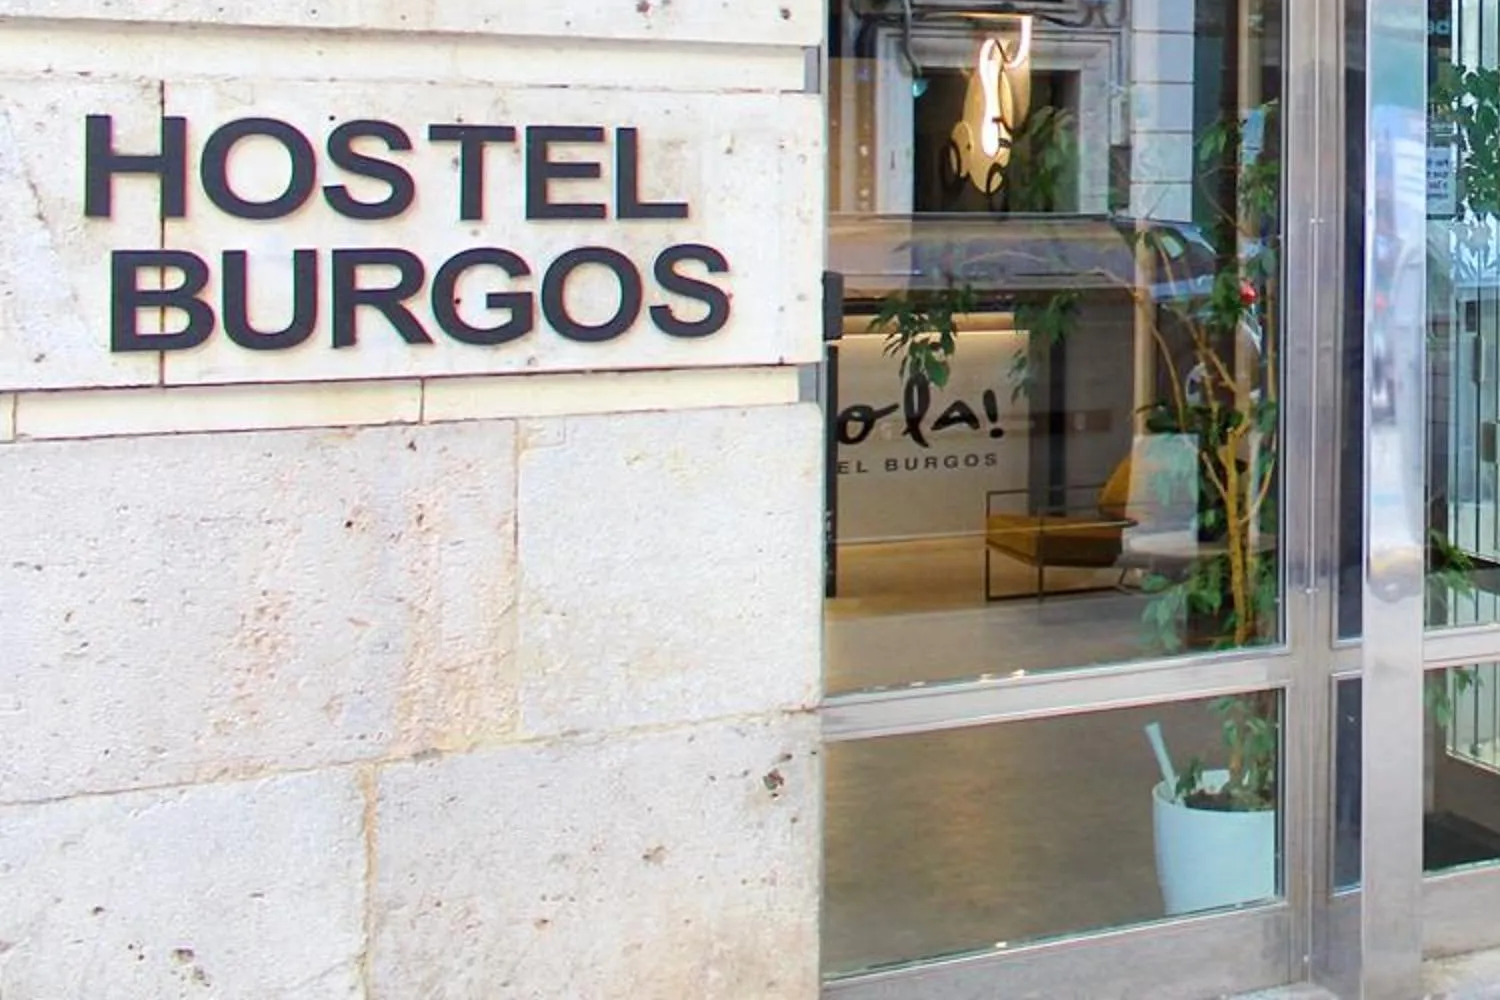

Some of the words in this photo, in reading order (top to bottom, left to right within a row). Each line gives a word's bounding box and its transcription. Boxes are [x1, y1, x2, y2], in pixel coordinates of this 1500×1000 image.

[85, 114, 689, 221] HOSTEL
[110, 243, 731, 353] BURGOS
[836, 373, 1004, 448] ola!
[885, 453, 998, 472] BURGOS
